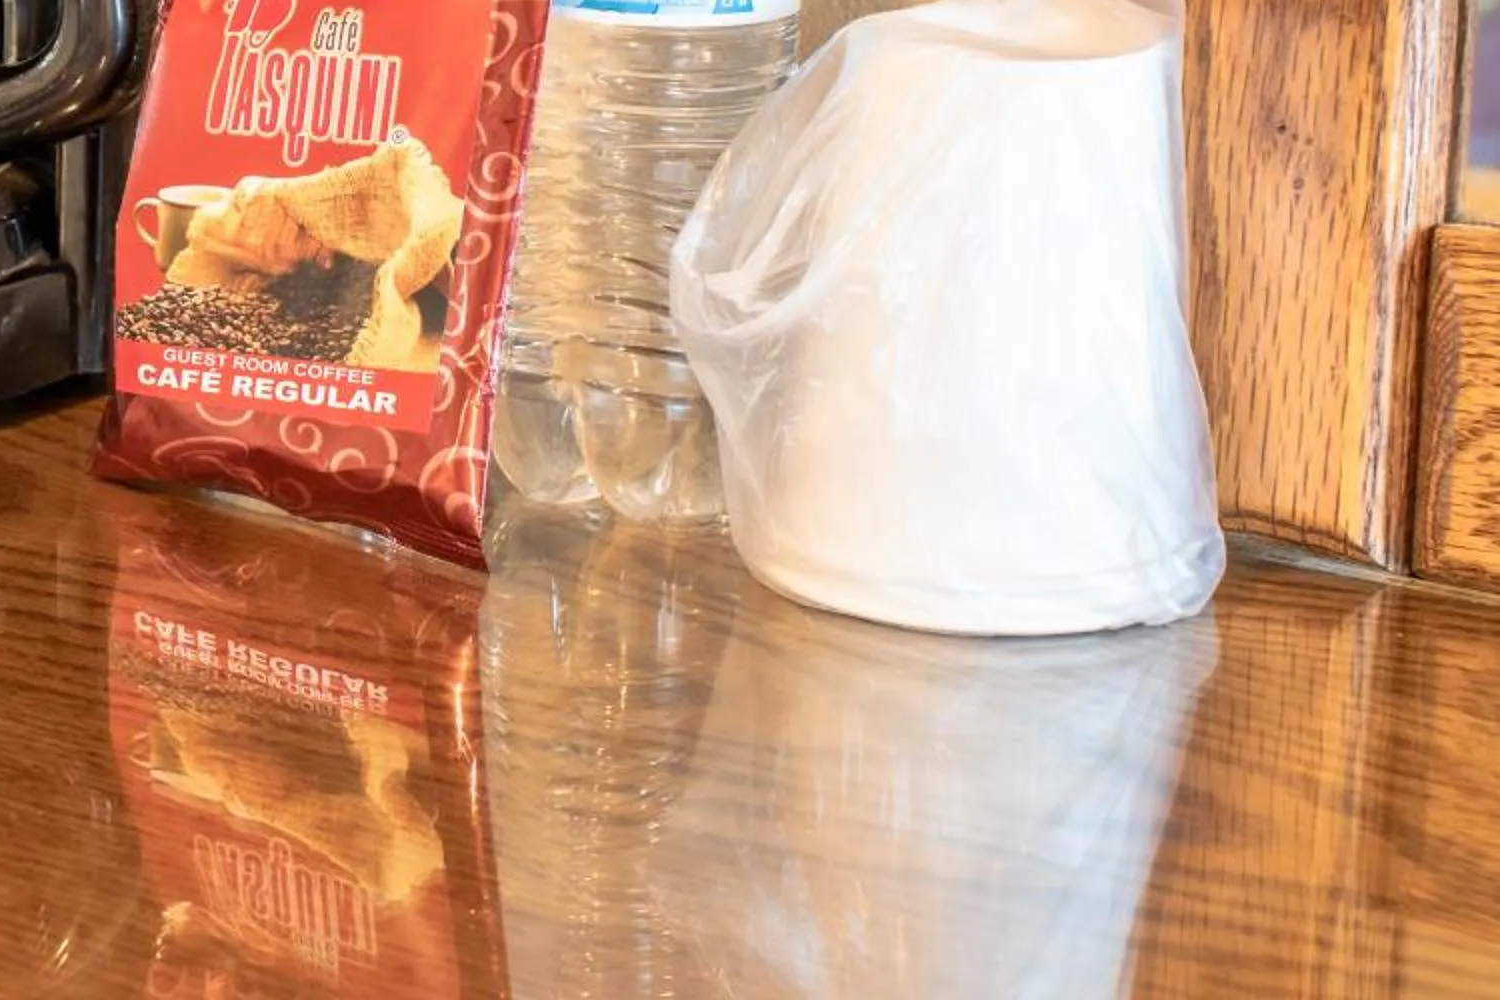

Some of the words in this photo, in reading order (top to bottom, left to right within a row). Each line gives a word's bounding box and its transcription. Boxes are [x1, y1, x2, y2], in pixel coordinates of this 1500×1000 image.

[312, 8, 361, 53] Café
[137, 364, 222, 394] CAFÉ
[231, 375, 398, 415] REGULAR
[163, 348, 227, 368] GUEST
[232, 355, 289, 375] ROOM
[293, 363, 377, 386] COFFEE
